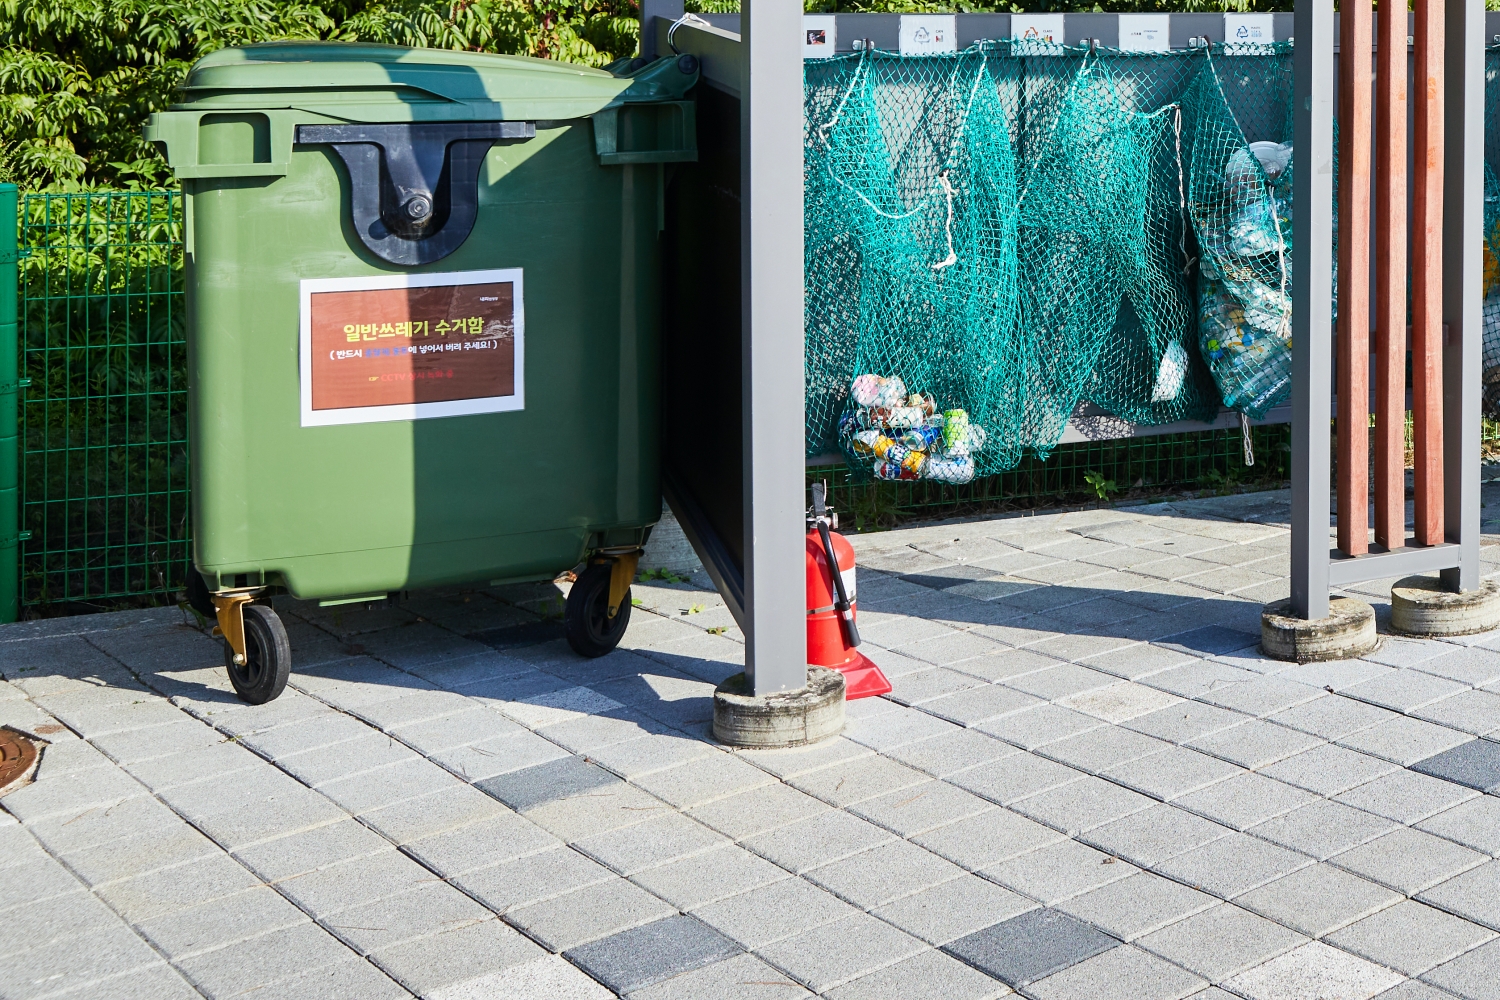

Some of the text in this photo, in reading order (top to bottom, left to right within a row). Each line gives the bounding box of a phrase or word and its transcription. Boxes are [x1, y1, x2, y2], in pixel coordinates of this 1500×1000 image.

[344, 316, 484, 343] 일반쓰레기 수거함
[336, 349, 362, 359] 반드시
[464, 340, 490, 350] 주세요!
[381, 371, 405, 382] CCTV
